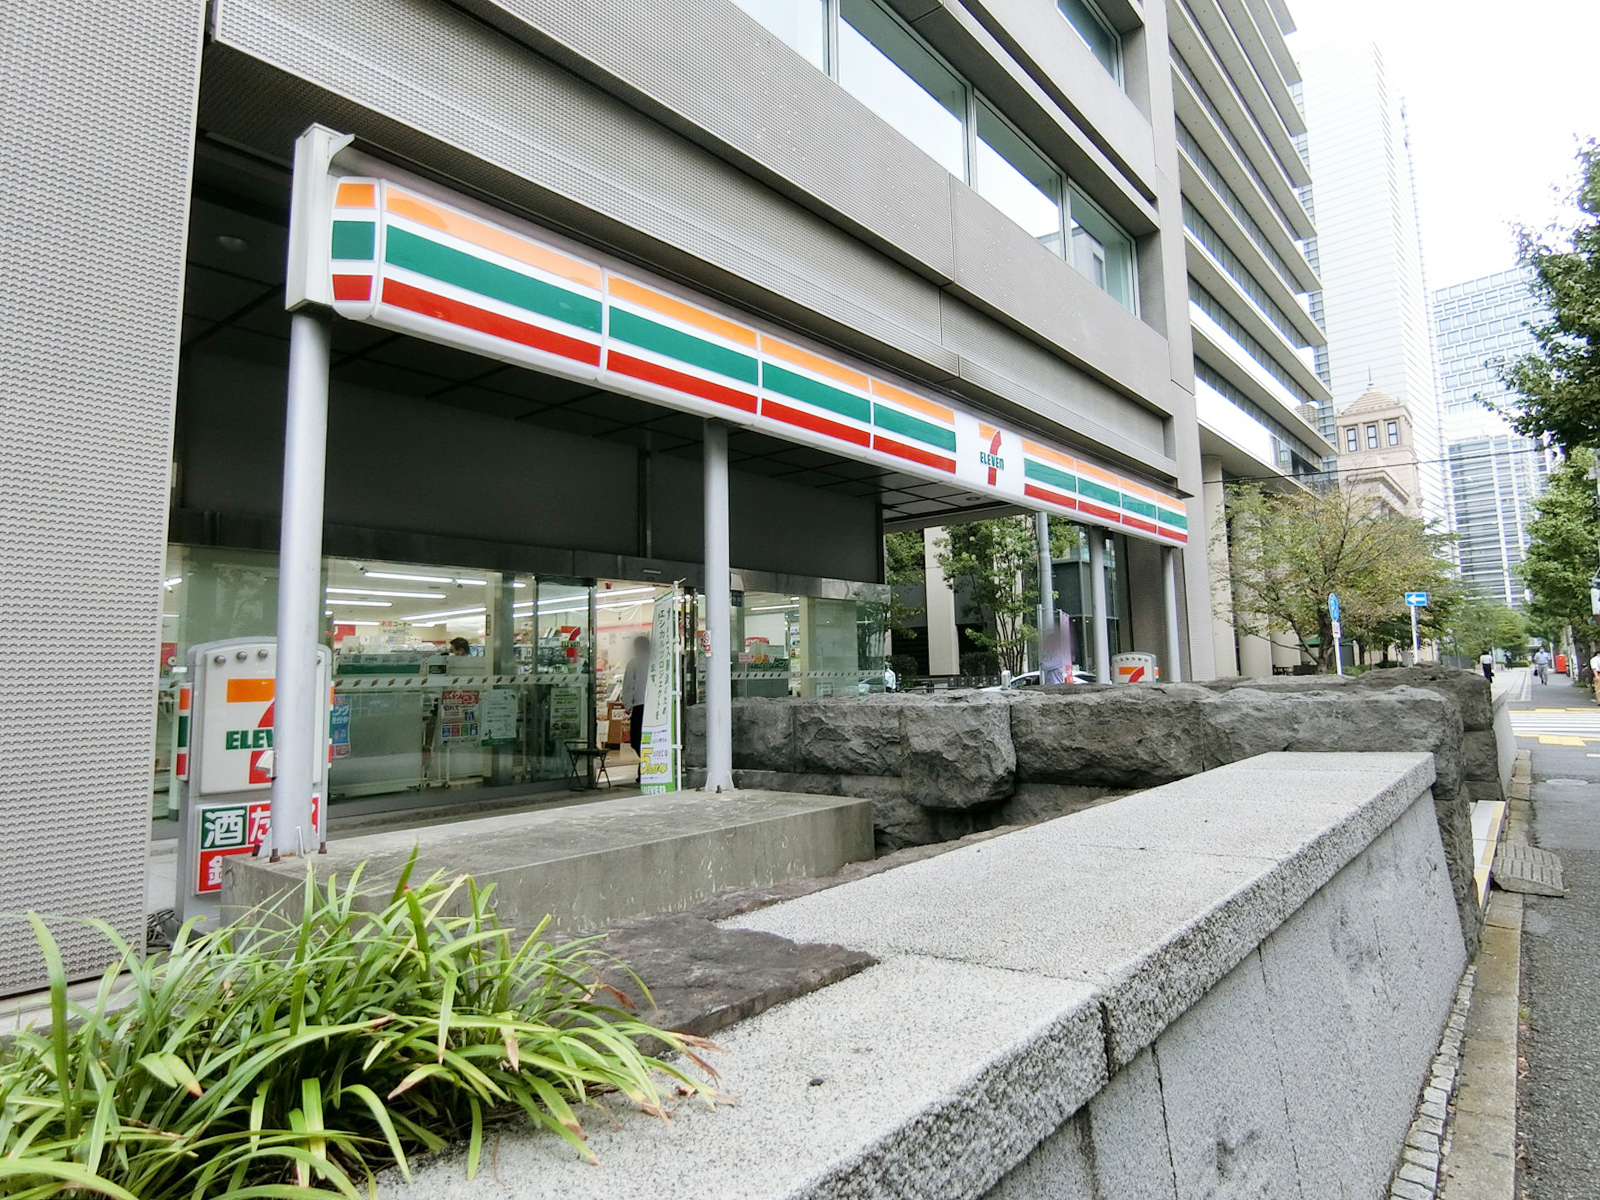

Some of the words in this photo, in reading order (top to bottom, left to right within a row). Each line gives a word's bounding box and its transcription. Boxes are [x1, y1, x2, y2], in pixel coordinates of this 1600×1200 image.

[978, 422, 1003, 487] 7
[560, 625, 581, 658] 7
[204, 808, 247, 848] 酒
